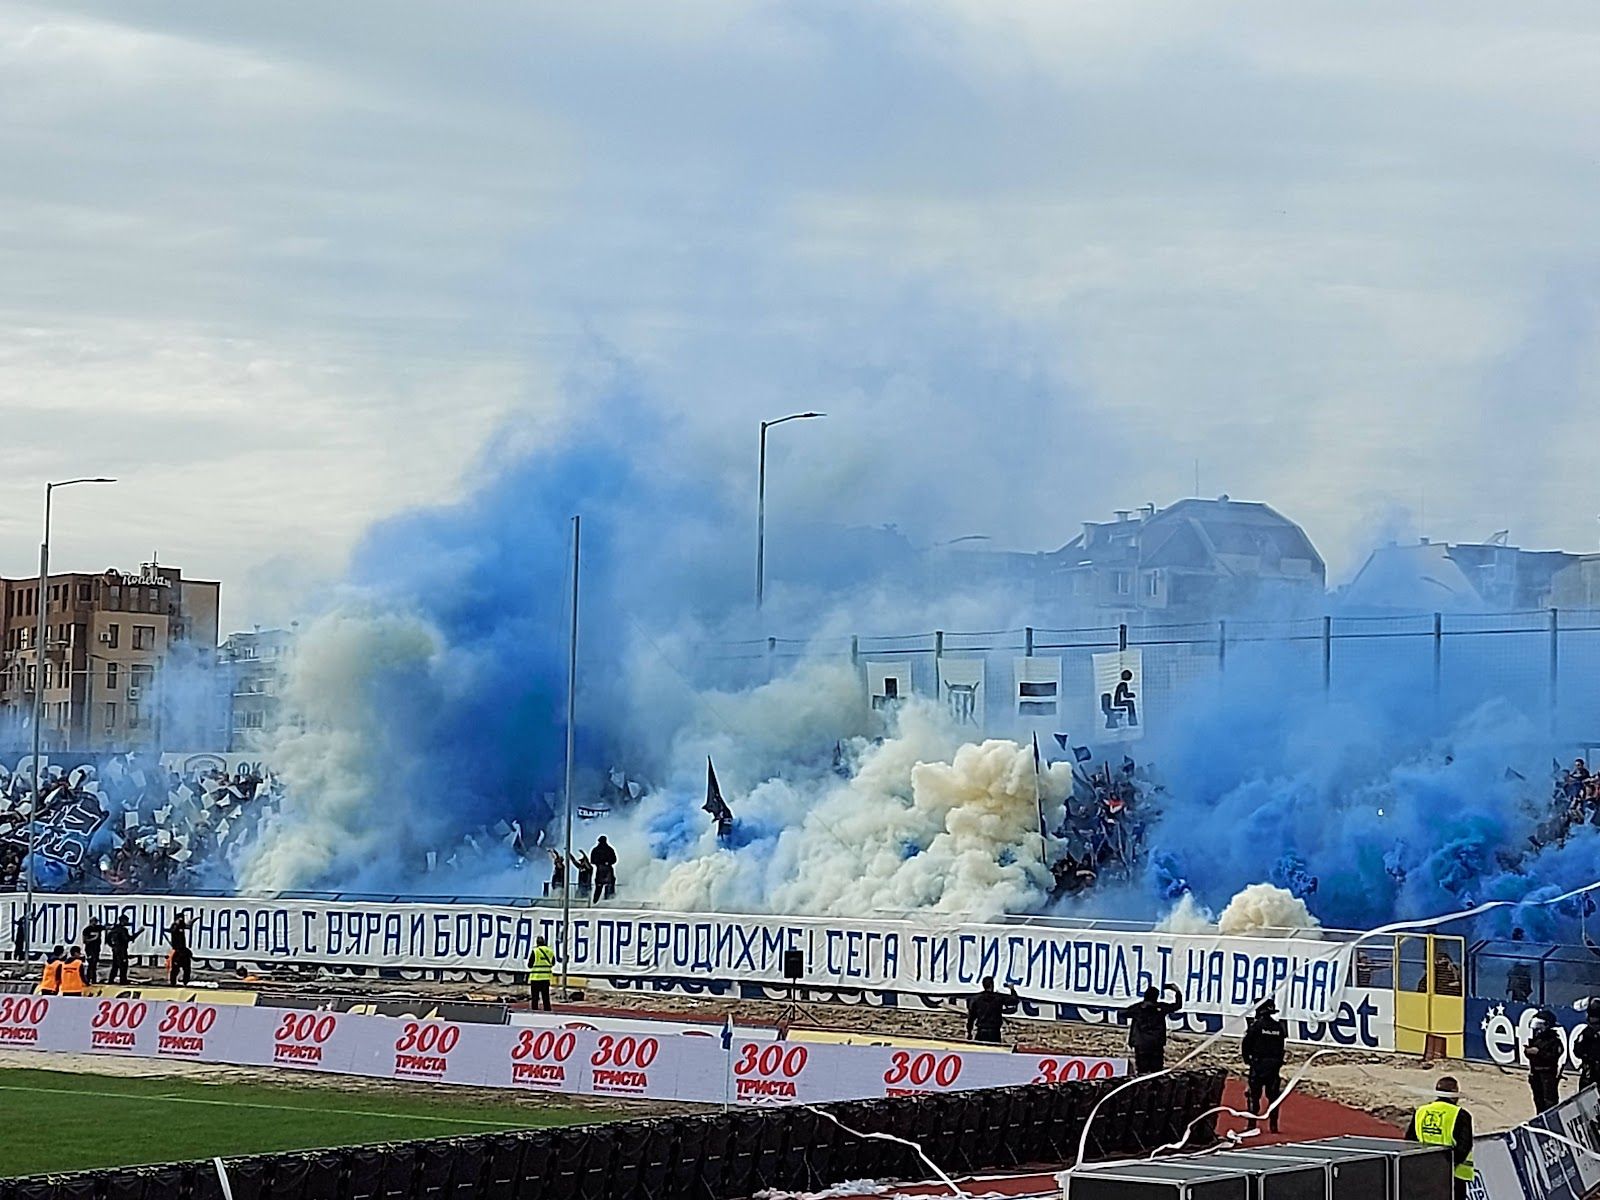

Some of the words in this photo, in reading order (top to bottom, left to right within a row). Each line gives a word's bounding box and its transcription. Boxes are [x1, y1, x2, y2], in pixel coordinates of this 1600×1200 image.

[302, 910, 317, 953] С
[325, 911, 400, 957] ВЯРА
[409, 913, 425, 957] И
[433, 913, 532, 960] БОРБА
[826, 929, 898, 979] СЕГА
[912, 935, 948, 983] ТИ
[959, 935, 999, 984] СИ
[1005, 936, 1173, 1000] СИМВОЛЪТ
[1185, 948, 1224, 1003] НА
[0, 997, 49, 1025] 300
[91, 1001, 147, 1029] 300
[158, 1005, 216, 1034] 300
[275, 1013, 336, 1044] 300
[396, 1023, 460, 1054] 300
[512, 1030, 576, 1062] 300
[591, 1035, 659, 1068] 300
[734, 1043, 808, 1077] 300
[884, 1051, 963, 1087] 300
